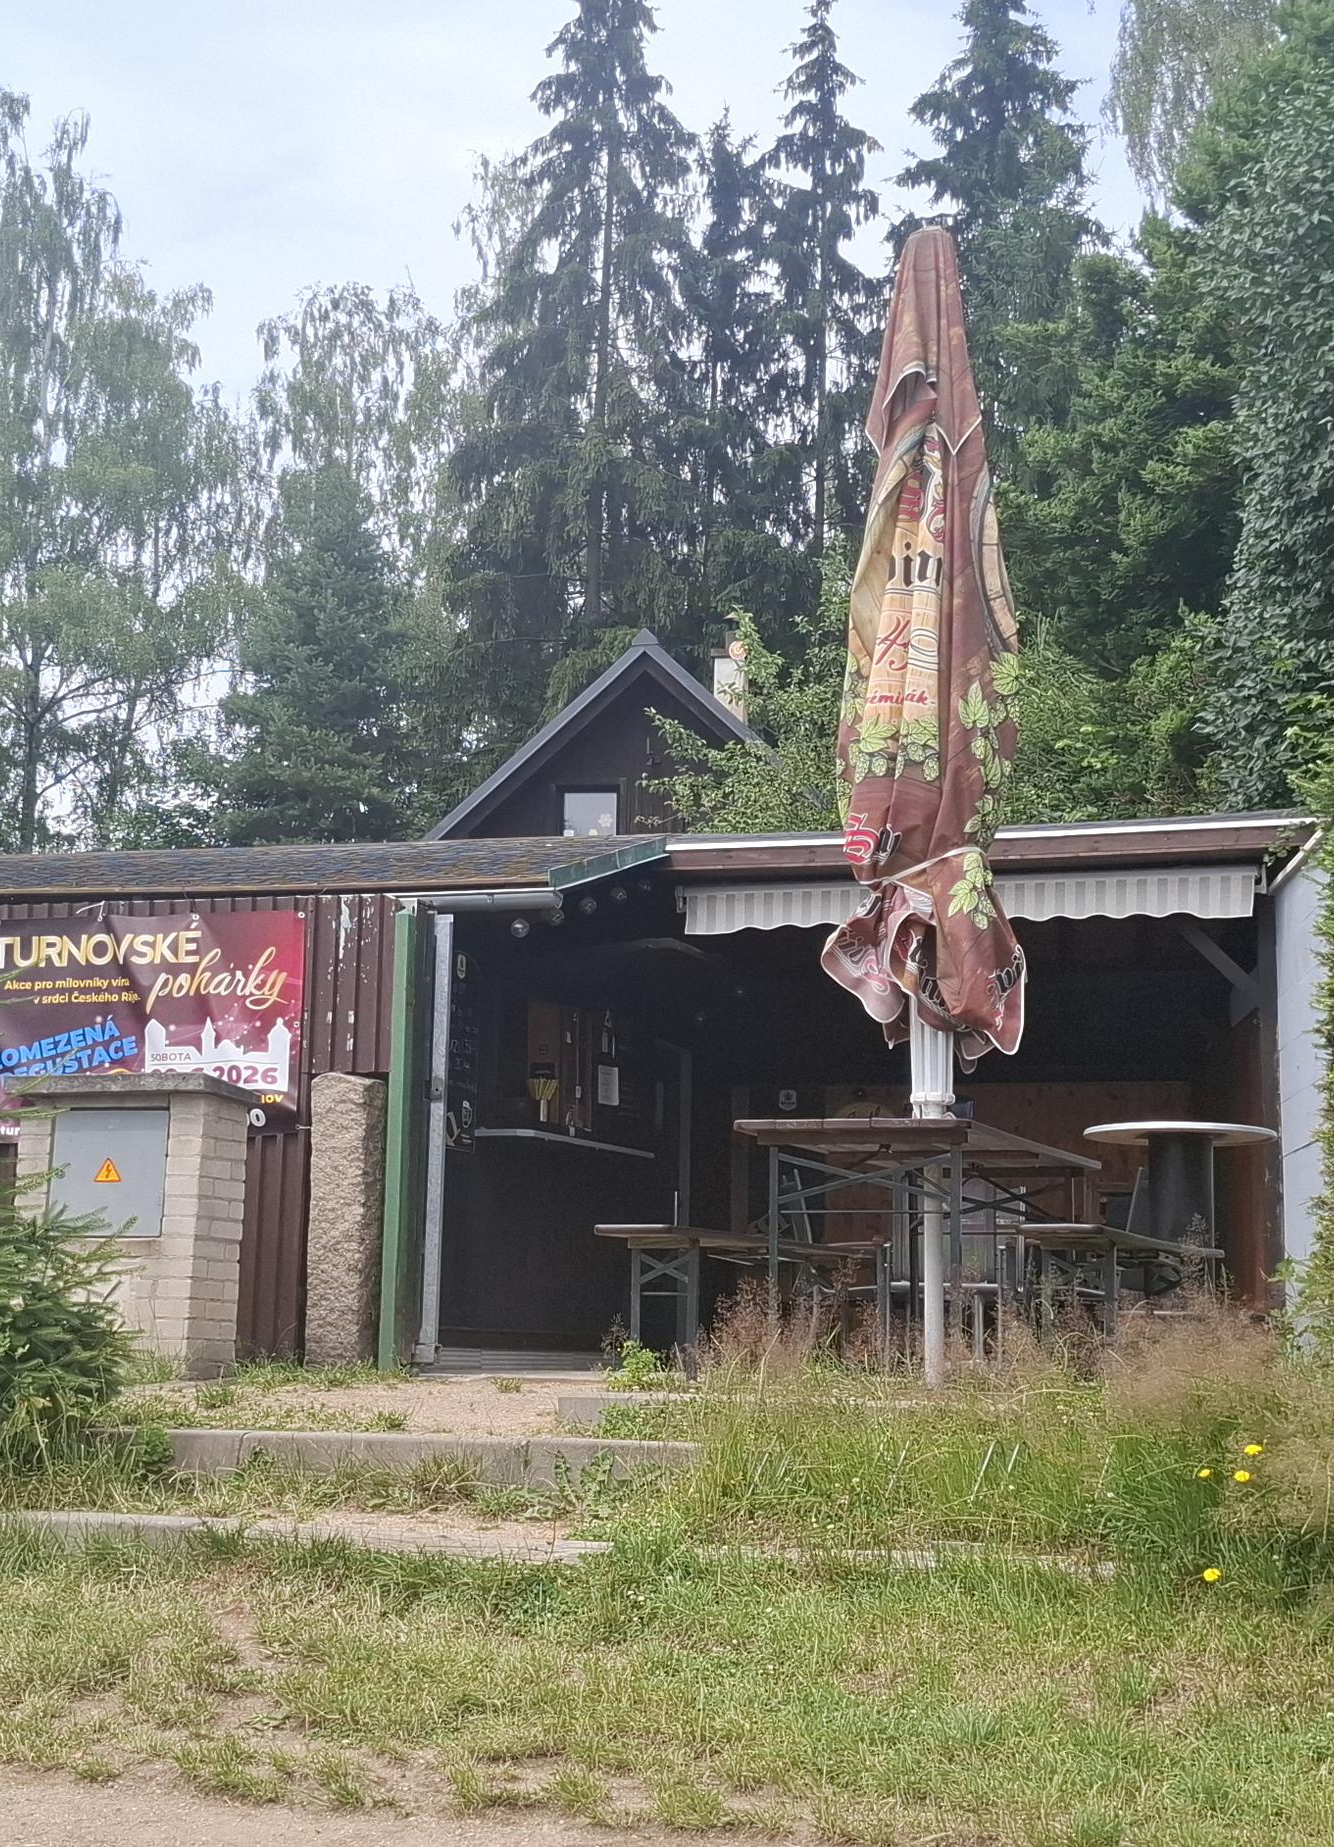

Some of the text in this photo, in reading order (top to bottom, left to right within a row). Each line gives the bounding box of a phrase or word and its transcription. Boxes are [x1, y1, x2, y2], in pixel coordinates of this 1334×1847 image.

[4, 980, 32, 990] Akce
[35, 981, 52, 991] pro
[55, 977, 109, 990] milovníky
[146, 946, 288, 1015] pohárky
[42, 993, 68, 1004] srdci
[71, 991, 119, 1003] Českého
[150, 1052, 192, 1062] SOBOTA
